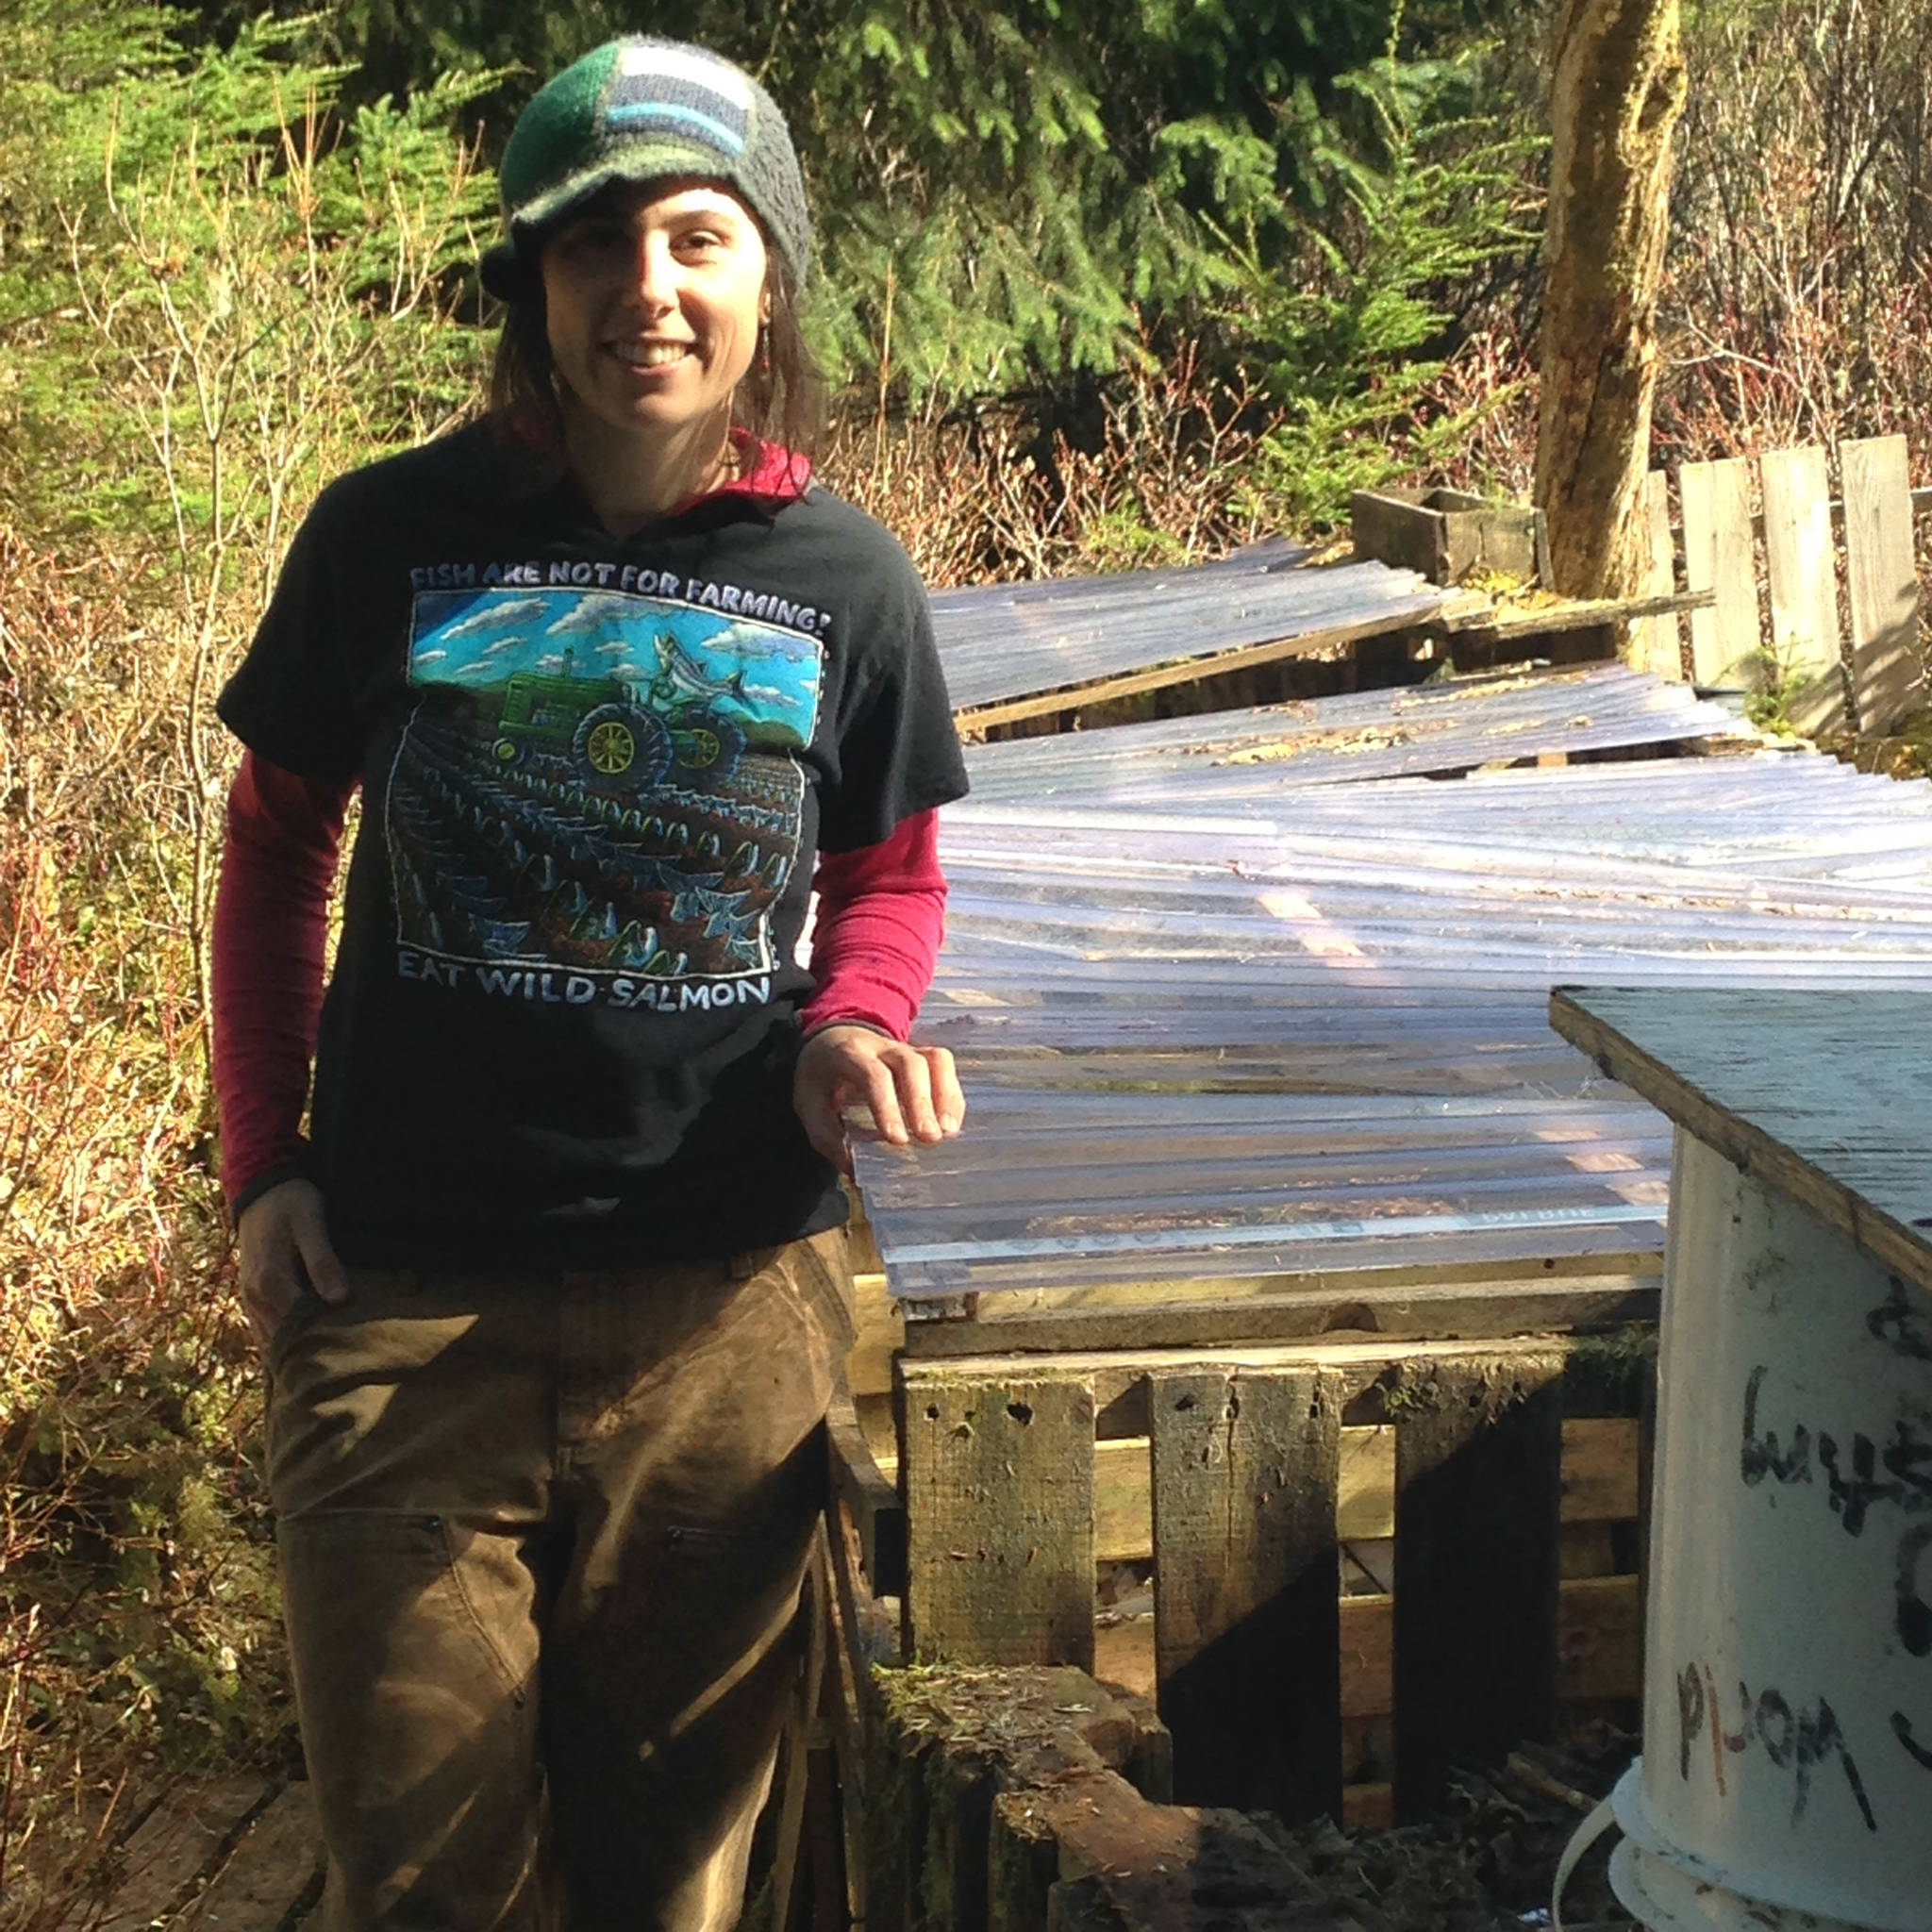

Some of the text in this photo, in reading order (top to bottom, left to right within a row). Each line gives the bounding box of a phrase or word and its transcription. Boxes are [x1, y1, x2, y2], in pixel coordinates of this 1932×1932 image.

[410, 564, 474, 587] FISH
[481, 563, 541, 585] ARE
[548, 562, 616, 585] NOT
[621, 566, 678, 596] FOR
[397, 951, 772, 1012] EAT WILD SALMON
